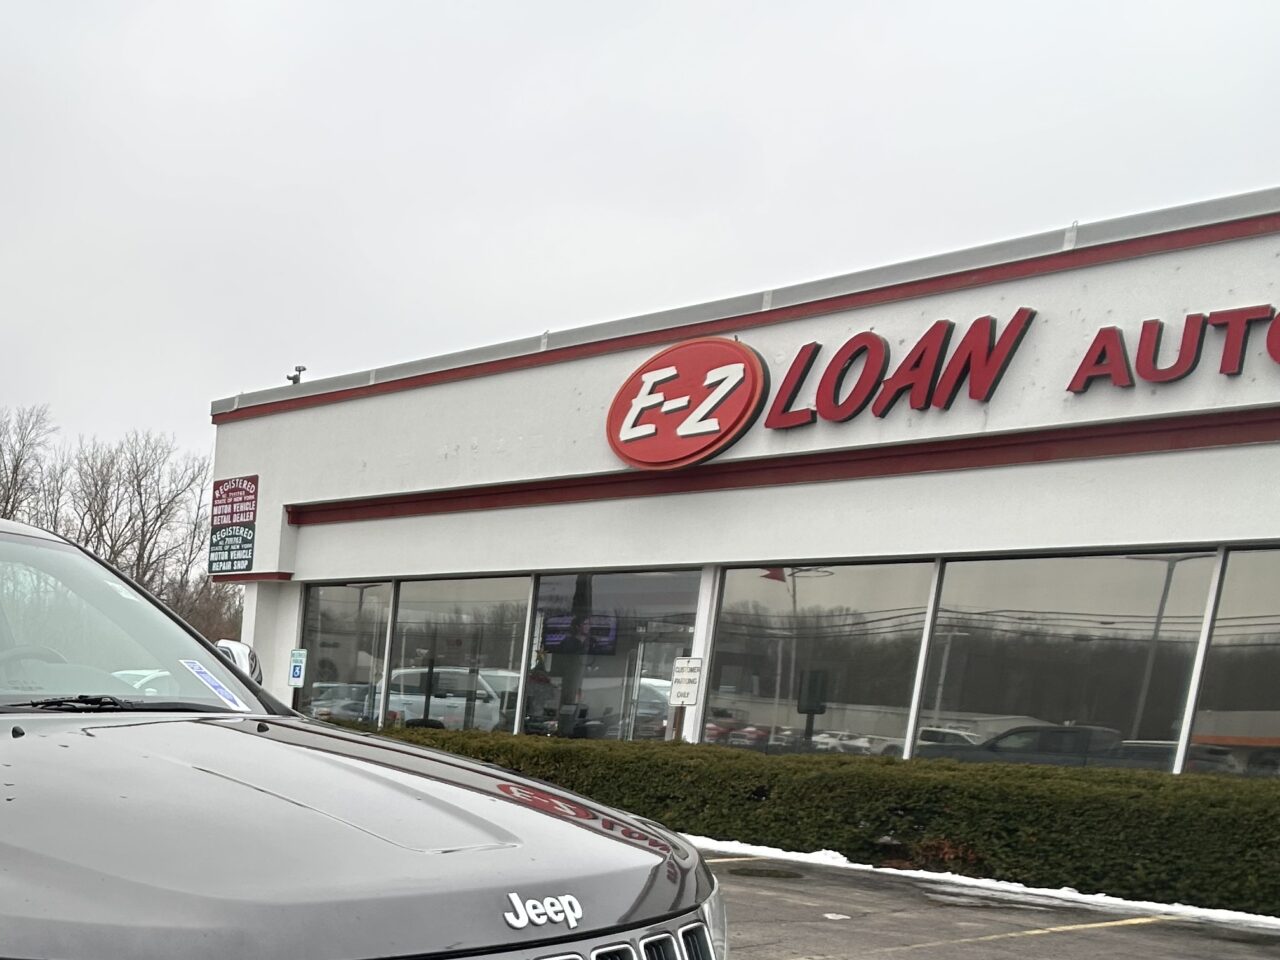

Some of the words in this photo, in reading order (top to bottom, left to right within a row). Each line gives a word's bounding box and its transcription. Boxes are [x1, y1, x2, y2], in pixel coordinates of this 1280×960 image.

[619, 362, 746, 443] E-Z
[763, 306, 1037, 430] LOAN
[1065, 303, 1280, 395] AUT
[214, 478, 256, 498] REGISTERED
[213, 504, 232, 515] MOTOR
[233, 500, 256, 512] VEHICLE
[213, 514, 232, 525] RETAIL
[232, 511, 254, 523] DEALER
[211, 526, 254, 544] REGISTERED
[210, 551, 229, 561] MOTOR
[230, 549, 252, 560] VEHICLE
[212, 561, 232, 571] REPAIR
[233, 559, 249, 570] SHOP
[503, 891, 583, 930] Jeep
